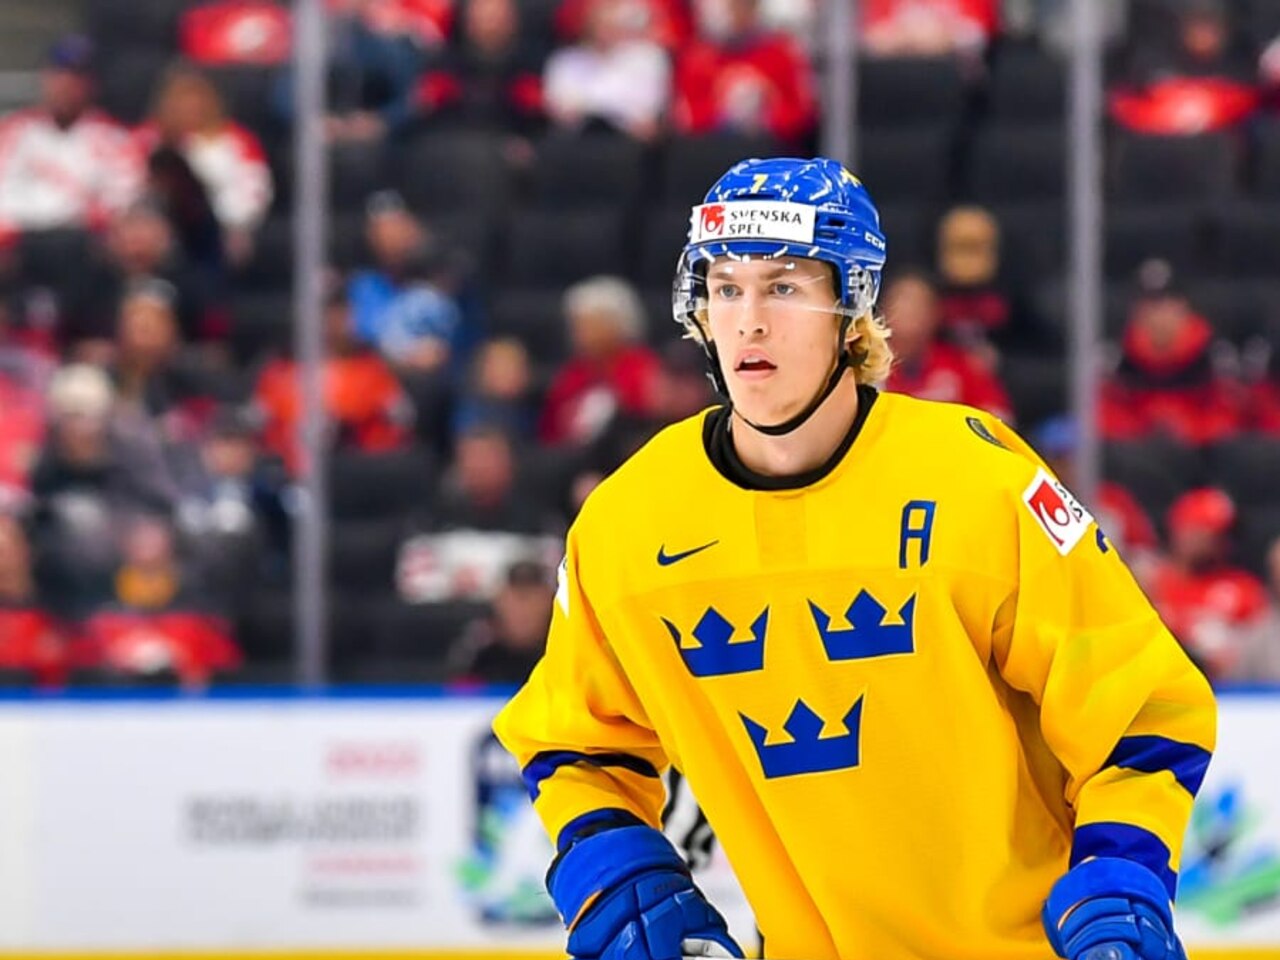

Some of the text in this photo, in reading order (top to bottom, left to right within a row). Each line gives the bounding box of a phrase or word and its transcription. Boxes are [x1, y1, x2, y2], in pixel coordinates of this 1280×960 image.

[753, 174, 768, 193] 7
[731, 209, 802, 224] SVENSKA
[728, 223, 766, 235] SPEL
[864, 230, 886, 251] CCM
[898, 500, 936, 569] A
